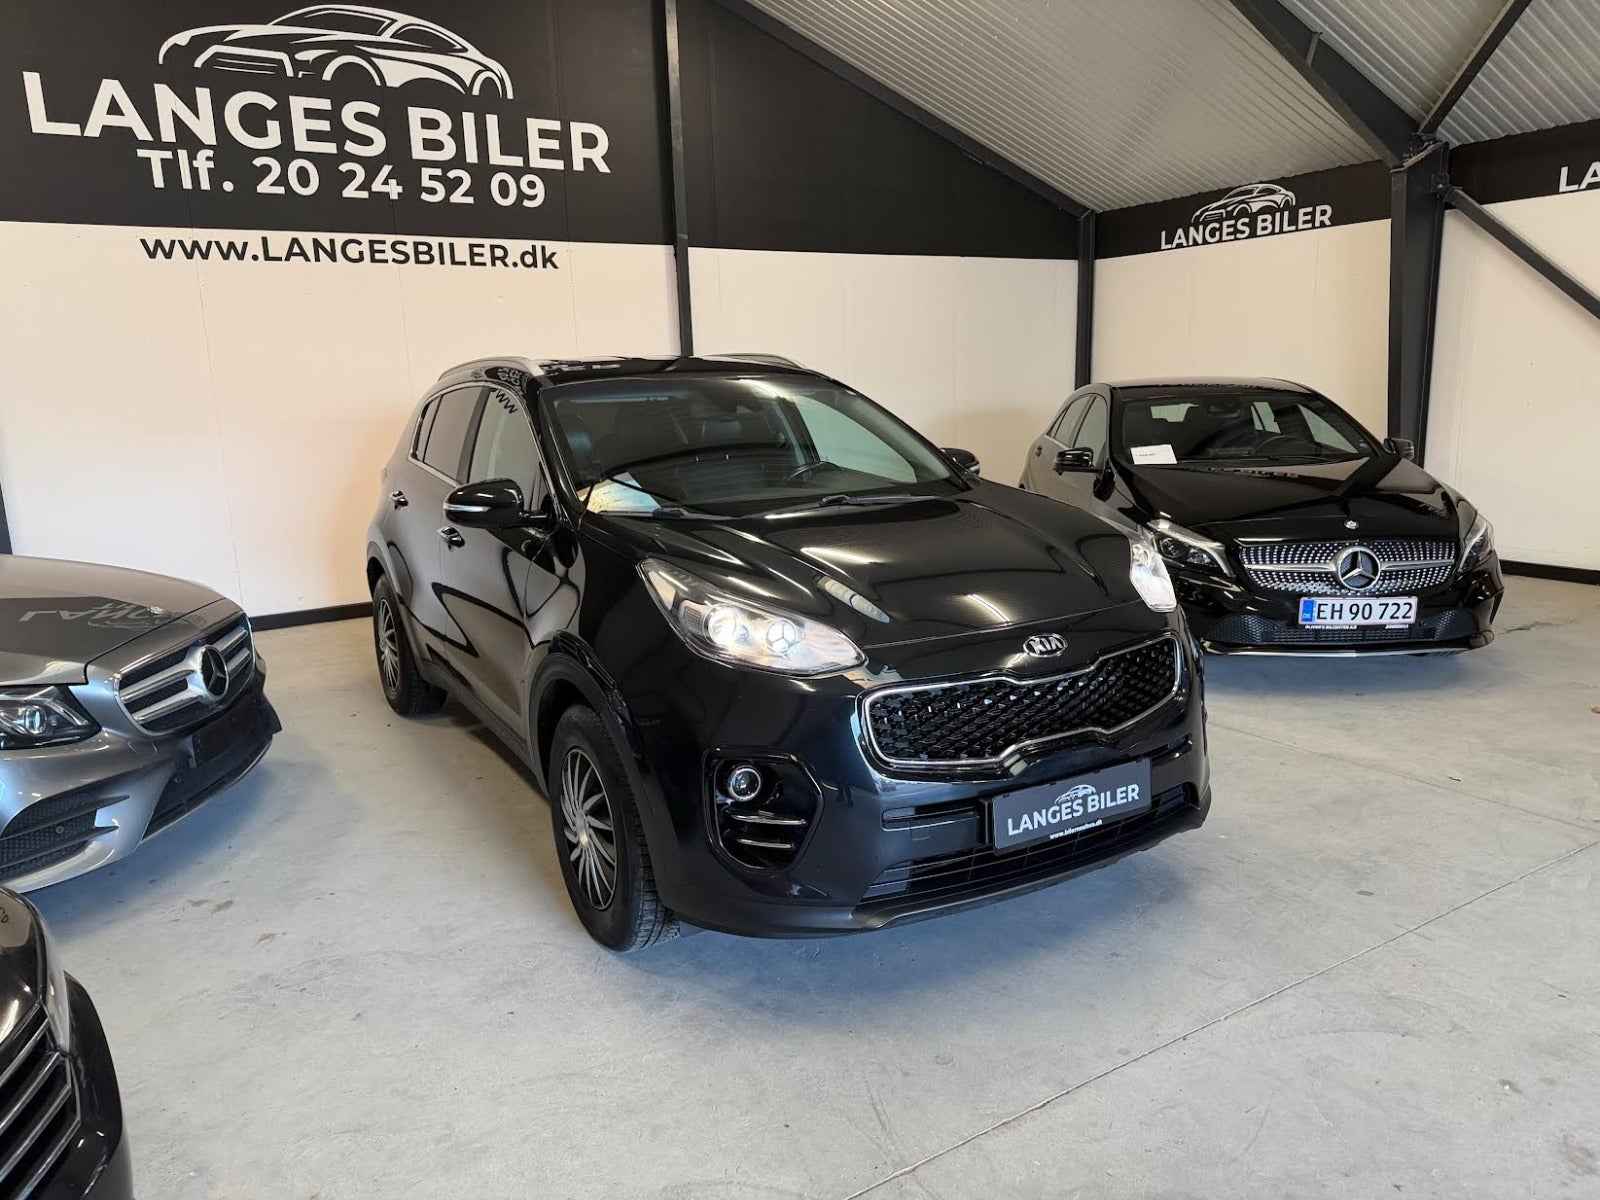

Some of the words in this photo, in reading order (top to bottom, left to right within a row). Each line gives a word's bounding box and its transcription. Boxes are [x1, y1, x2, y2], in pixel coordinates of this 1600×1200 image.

[22, 71, 388, 158] LANGES
[407, 106, 611, 174] BILER
[136, 148, 235, 193] Tlf.
[251, 156, 320, 197] 20
[340, 161, 403, 200] 24
[420, 167, 475, 205] 52
[490, 171, 546, 209] 09
[1160, 217, 1251, 250] LANGES
[1256, 204, 1333, 237] BILER
[139, 235, 560, 271] www.LANGESBILER.dk
[1316, 603, 1344, 620] EH
[1349, 602, 1373, 621] 90
[1378, 602, 1413, 620] 722
[1028, 637, 1063, 654] KIA
[1007, 798, 1084, 836] LANGES
[1087, 783, 1140, 813] BILER
